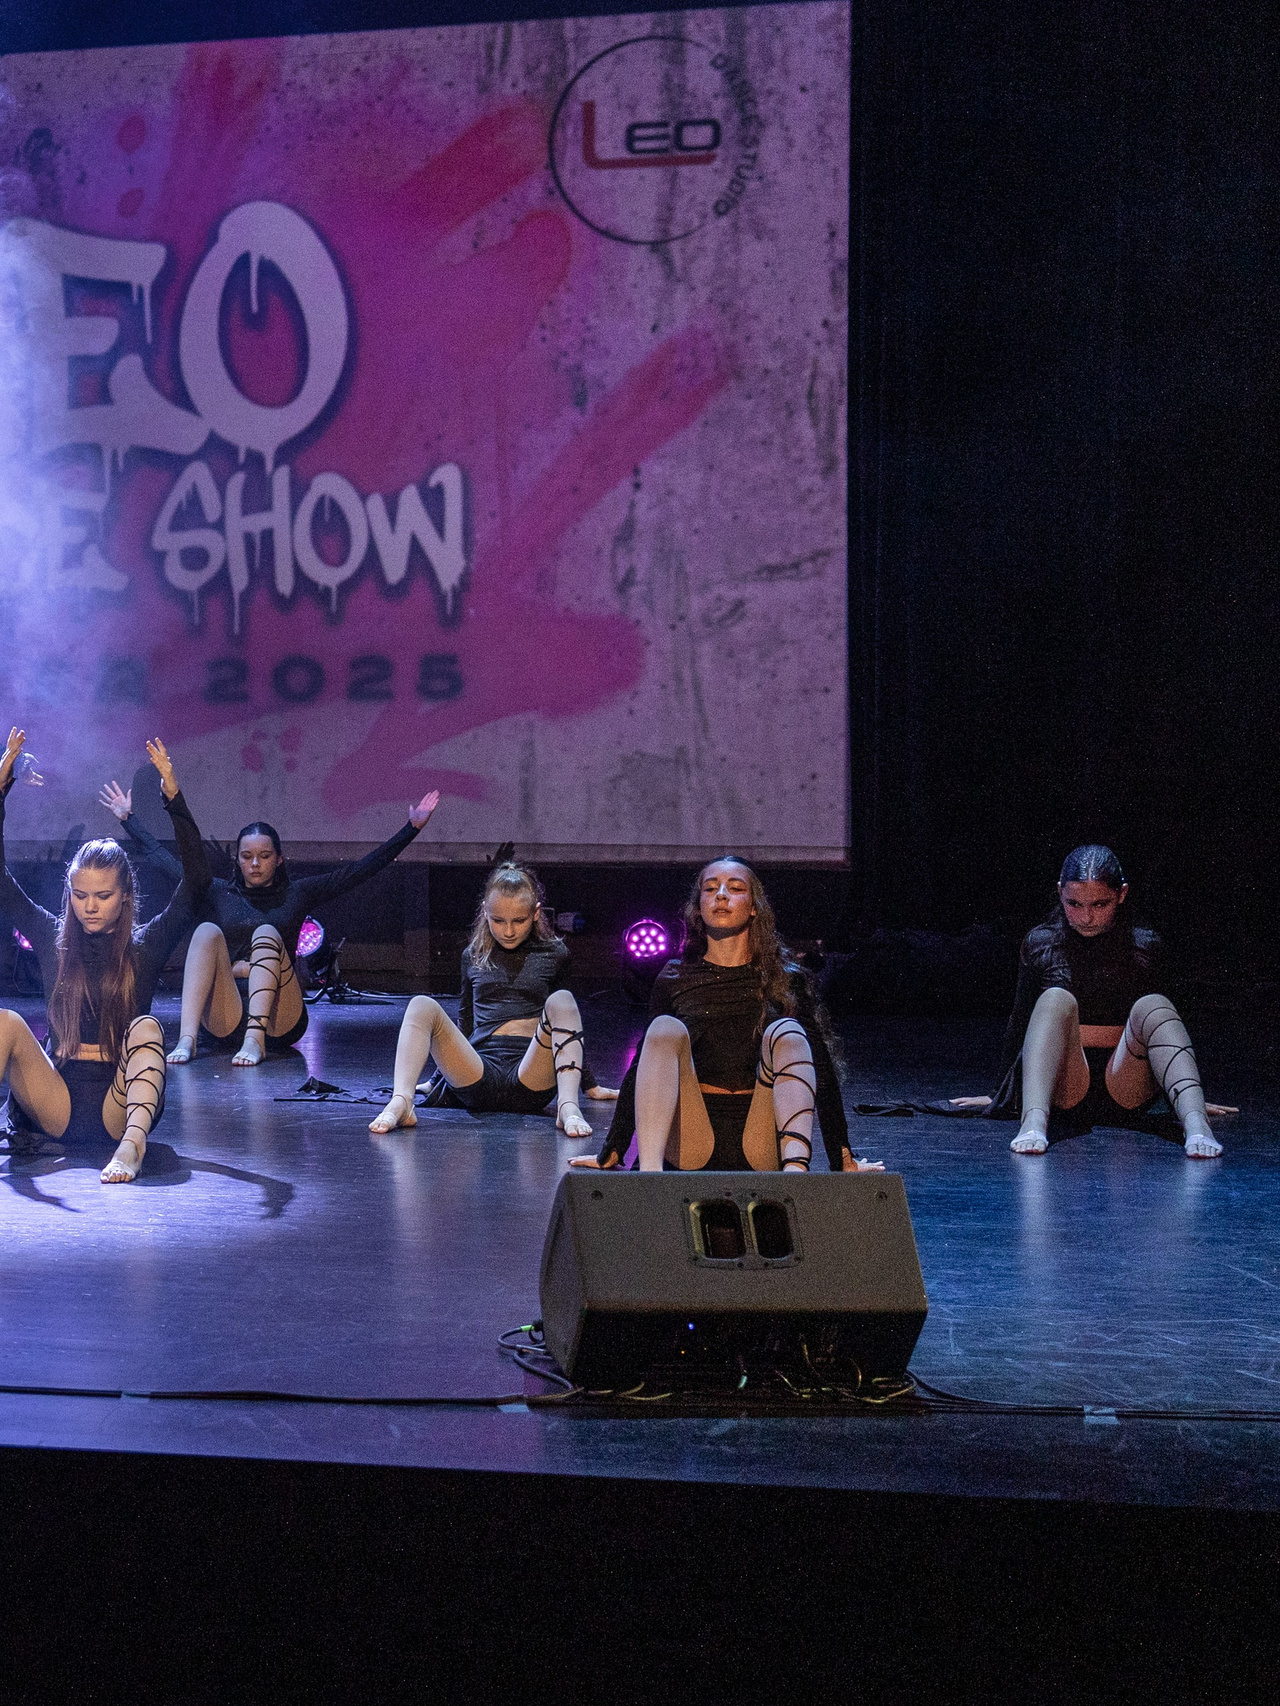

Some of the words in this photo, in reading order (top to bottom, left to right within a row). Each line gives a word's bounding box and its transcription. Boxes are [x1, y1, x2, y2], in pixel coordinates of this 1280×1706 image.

[581, 99, 723, 170] LEO
[712, 130, 760, 219] STUDIO
[152, 461, 467, 635] SHOW
[203, 653, 466, 703] 2025
